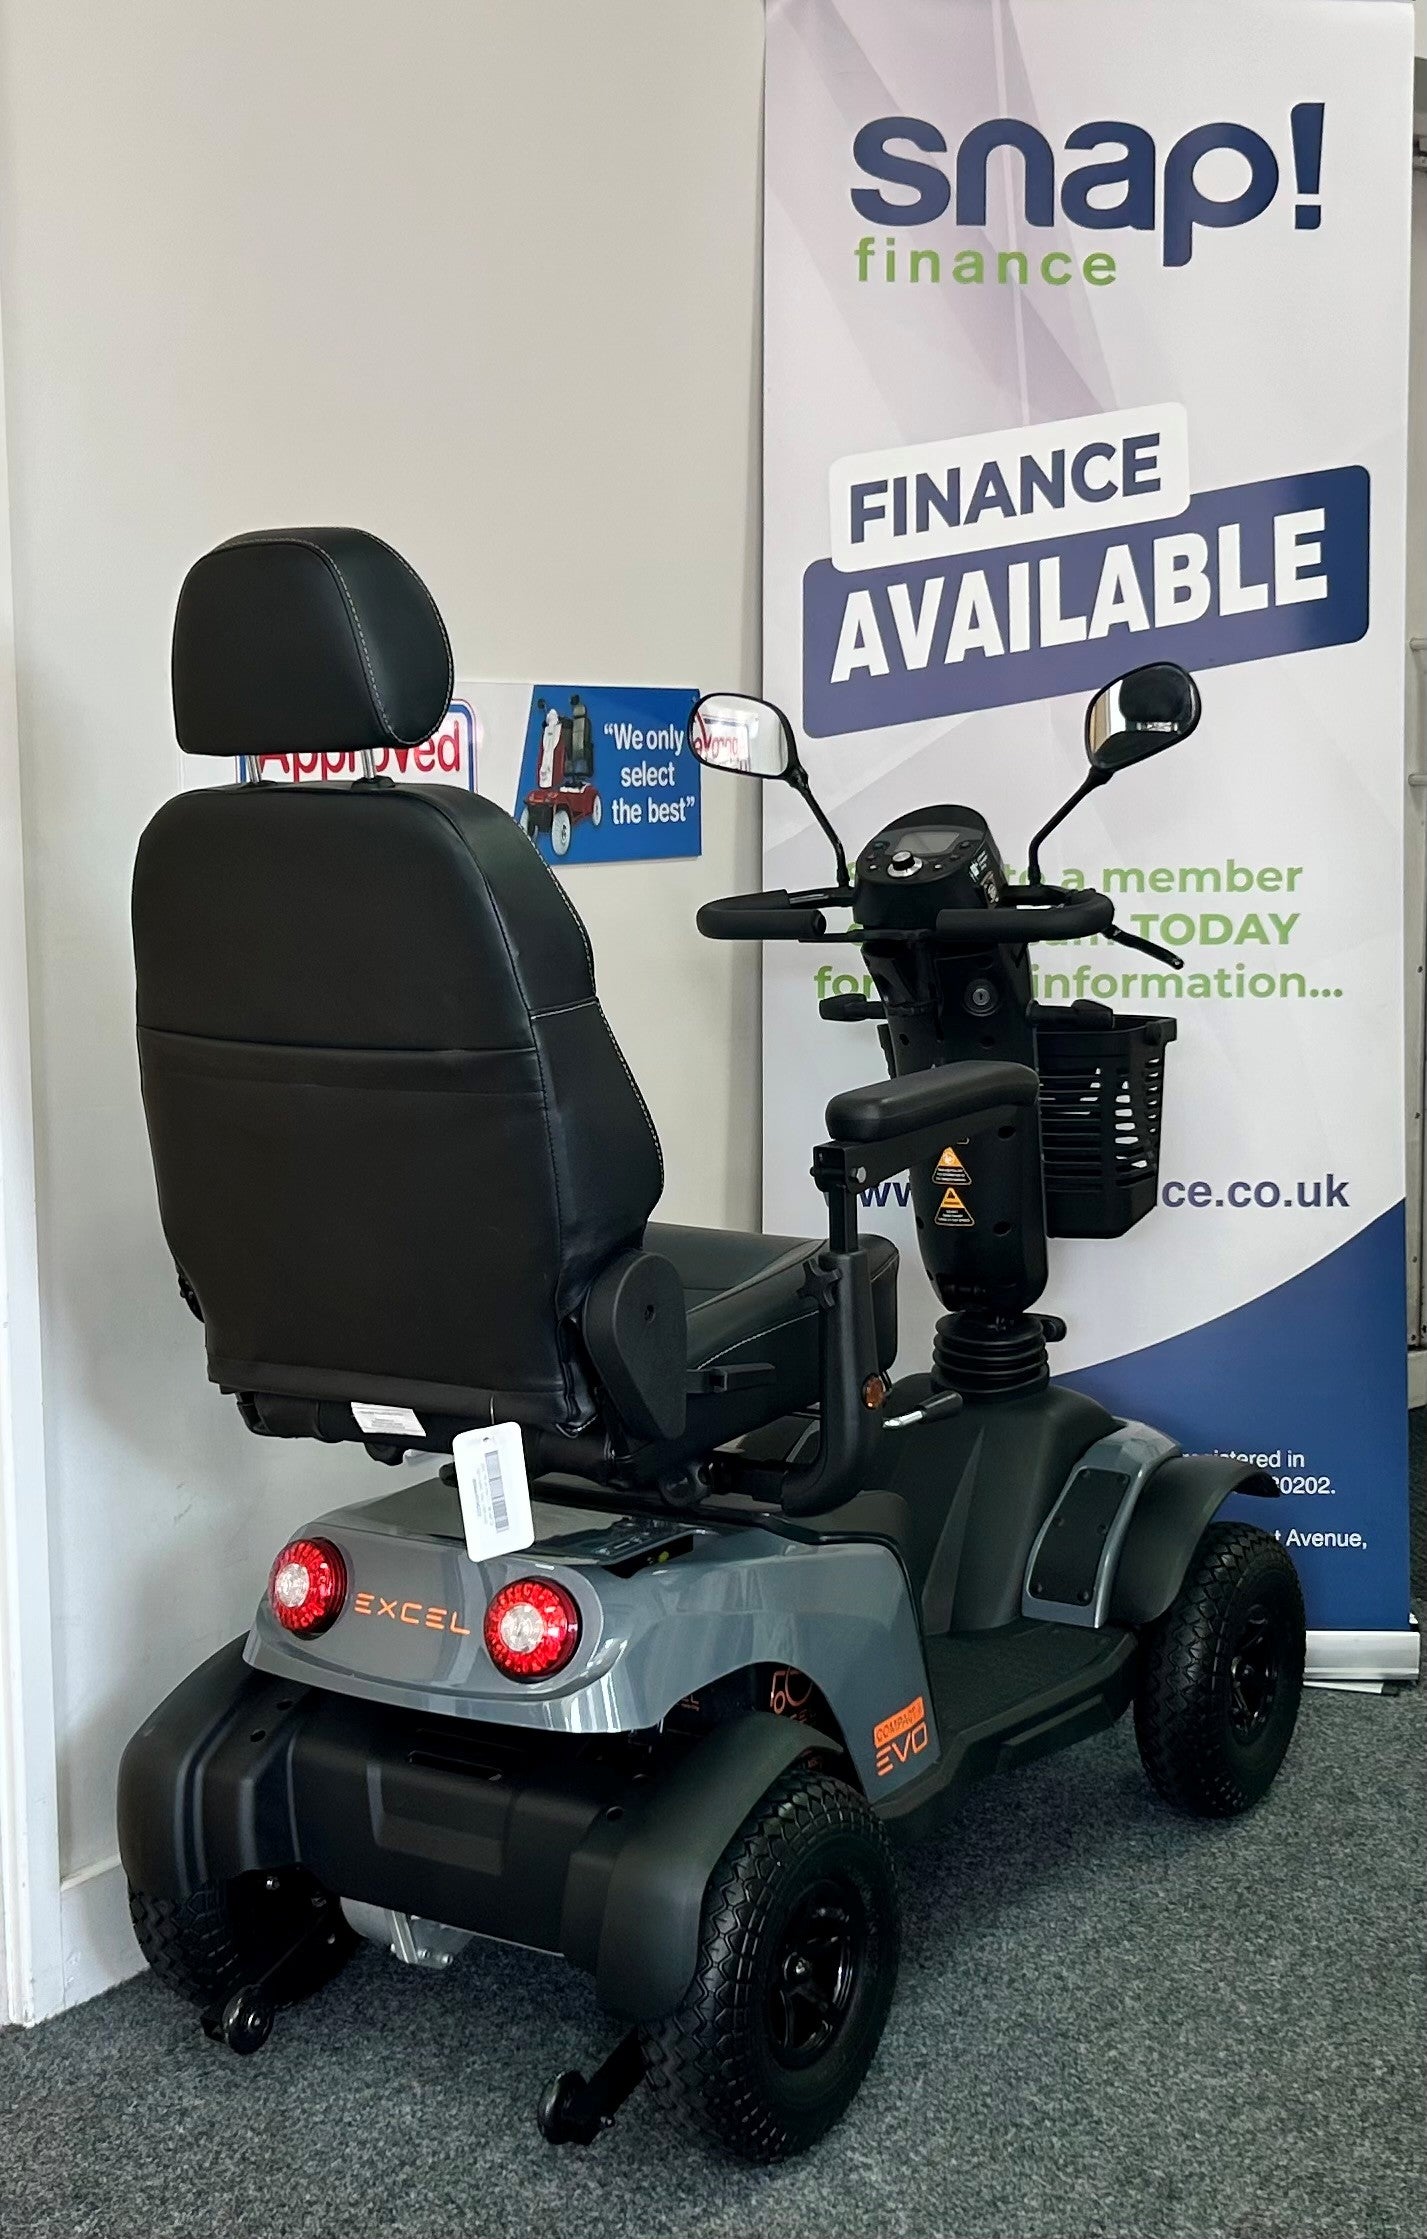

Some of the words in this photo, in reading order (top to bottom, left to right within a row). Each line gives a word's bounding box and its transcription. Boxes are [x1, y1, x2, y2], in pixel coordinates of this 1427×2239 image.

[851, 102, 1325, 267] snap!
[855, 235, 1118, 287] finance
[850, 432, 1161, 544] FINANCE
[830, 507, 1329, 684] AVAILABLE
[646, 723, 685, 757] only
[620, 760, 676, 788] select
[611, 797, 642, 825] the
[1060, 868, 1086, 892] a
[1101, 859, 1303, 894] member
[1129, 911, 1299, 947] TODAY
[813, 964, 875, 1000] for
[1031, 964, 1344, 1000] information...
[1287, 1449, 1305, 1468] in
[1285, 1528, 1367, 1550] Avenue,
[354, 1591, 471, 1635] EXCEL
[875, 1721, 929, 1777] EVO
